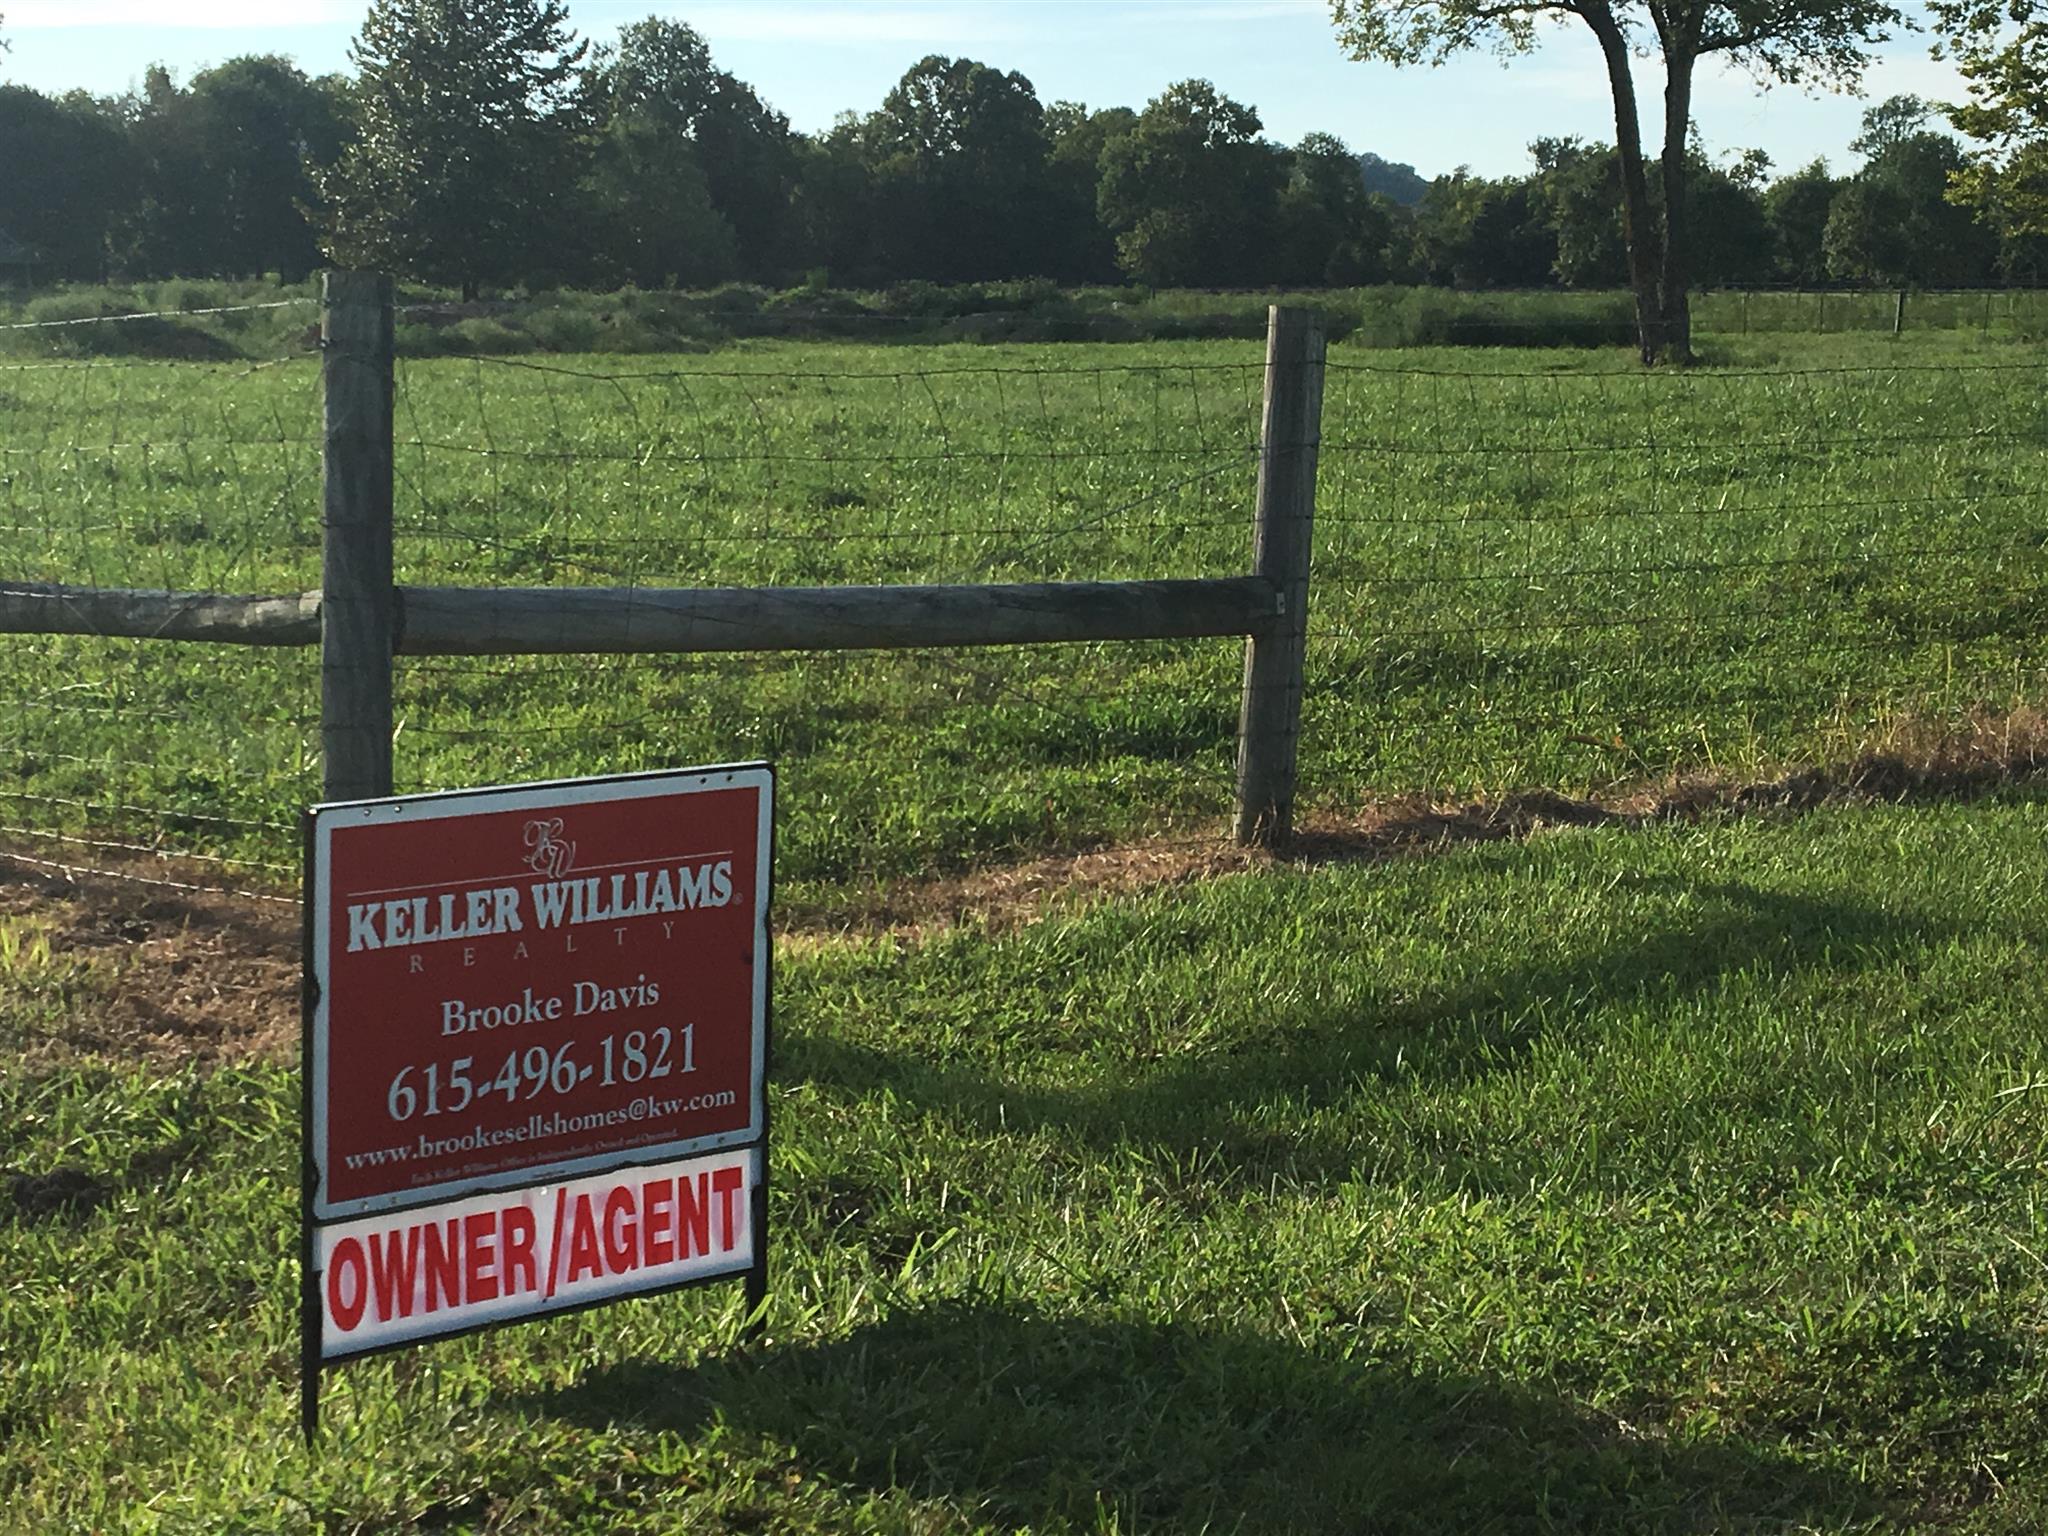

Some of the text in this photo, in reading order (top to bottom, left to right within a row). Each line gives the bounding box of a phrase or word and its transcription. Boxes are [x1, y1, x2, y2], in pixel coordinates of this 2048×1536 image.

[346, 860, 733, 953] KELLER WILLIAMS
[409, 920, 675, 974] REALTY
[440, 974, 660, 1036] Brooke Davis
[387, 1023, 697, 1121] 615-496-1821
[345, 1089, 736, 1169] www.brookesellshomes@kw.com
[328, 1166, 743, 1331] OWNER/AGENT
